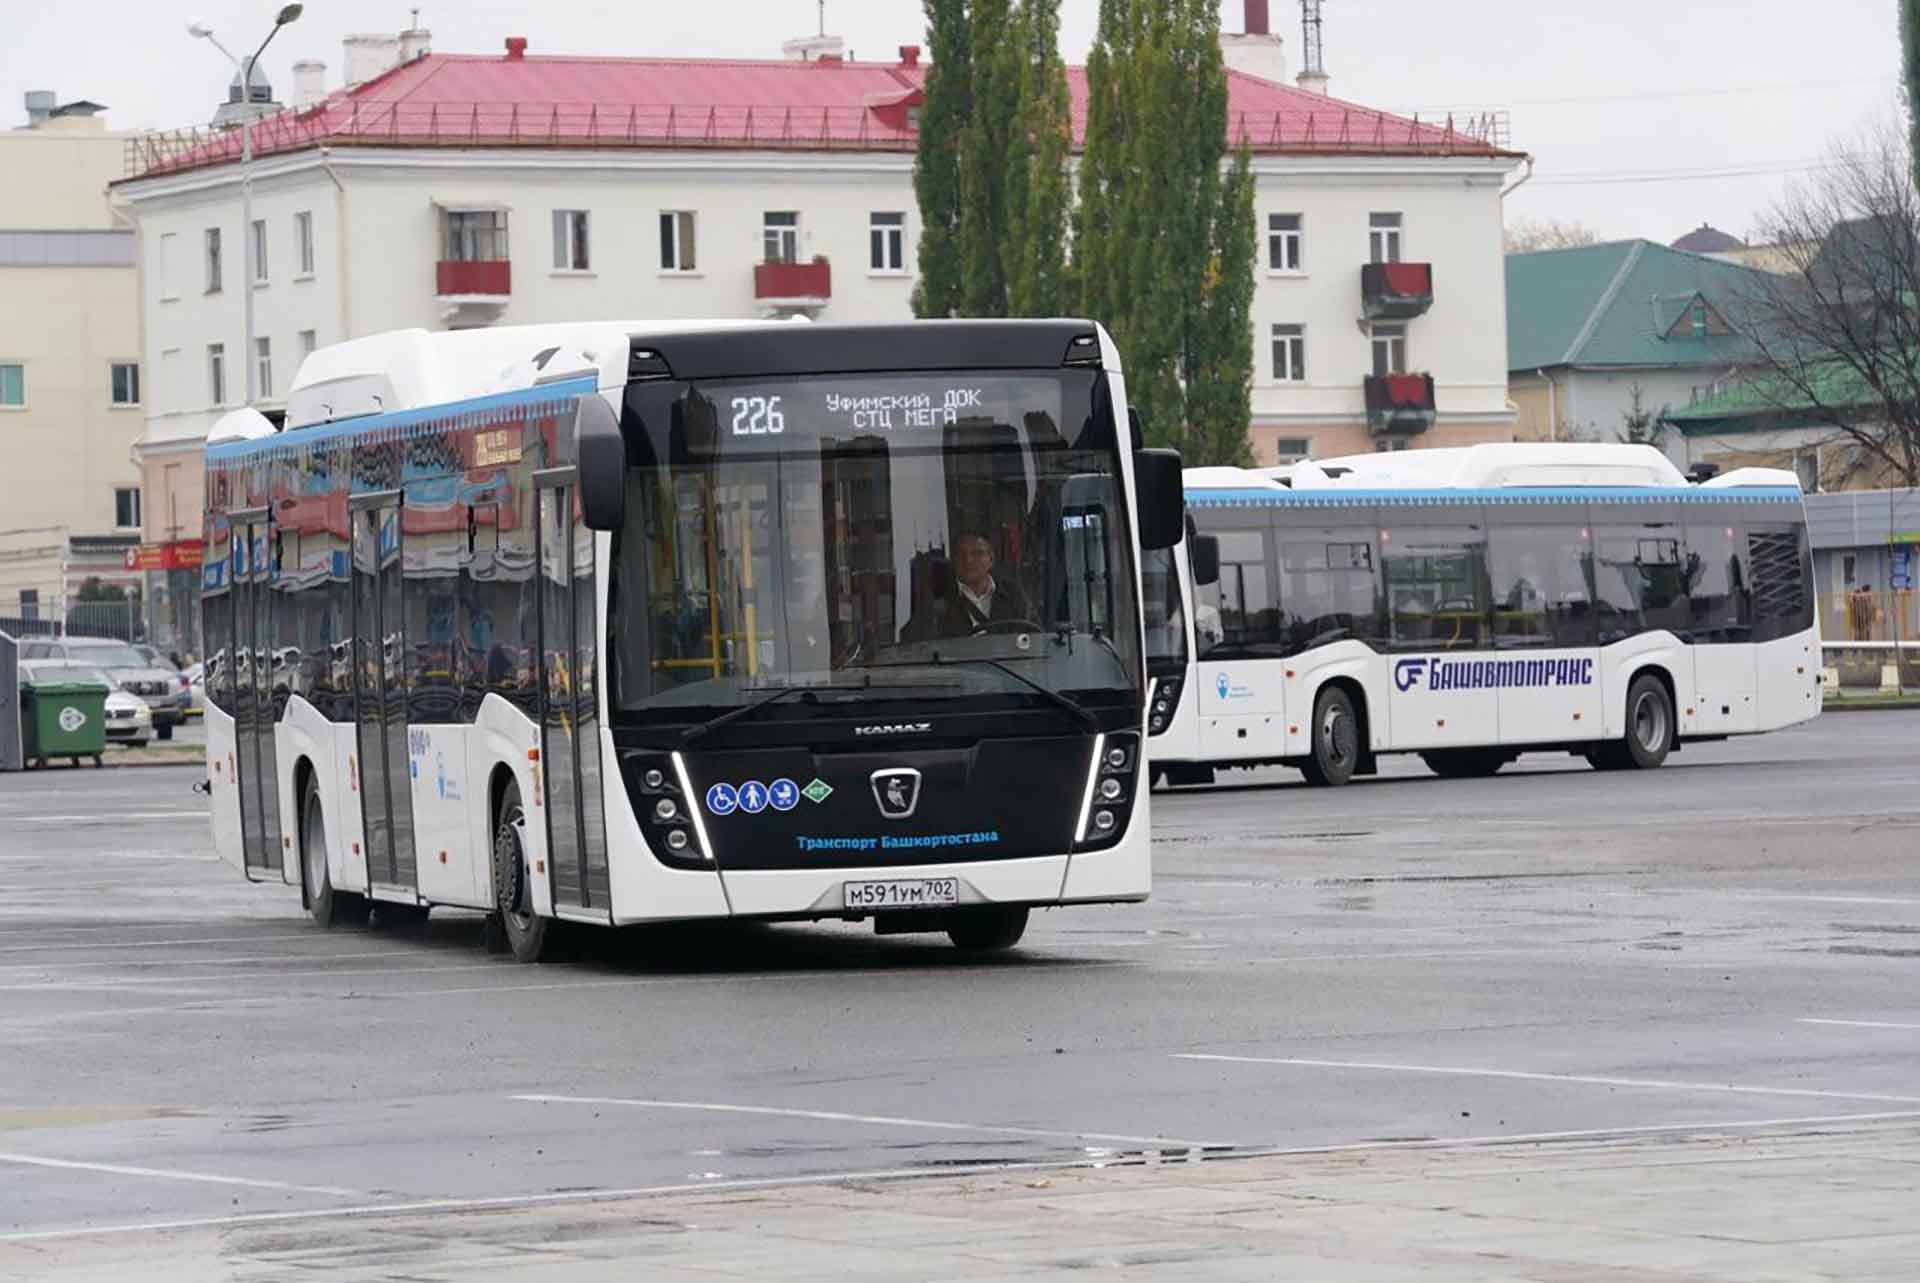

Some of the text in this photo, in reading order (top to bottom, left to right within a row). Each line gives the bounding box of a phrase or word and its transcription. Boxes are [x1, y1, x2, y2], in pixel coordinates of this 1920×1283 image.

[826, 389, 982, 412] Уфимский ДОК
[731, 396, 784, 435] 226
[853, 408, 957, 429] СТЦ МЕГА
[855, 723, 931, 735] KAMAZ
[797, 831, 998, 850] Транспорт Башкортостана
